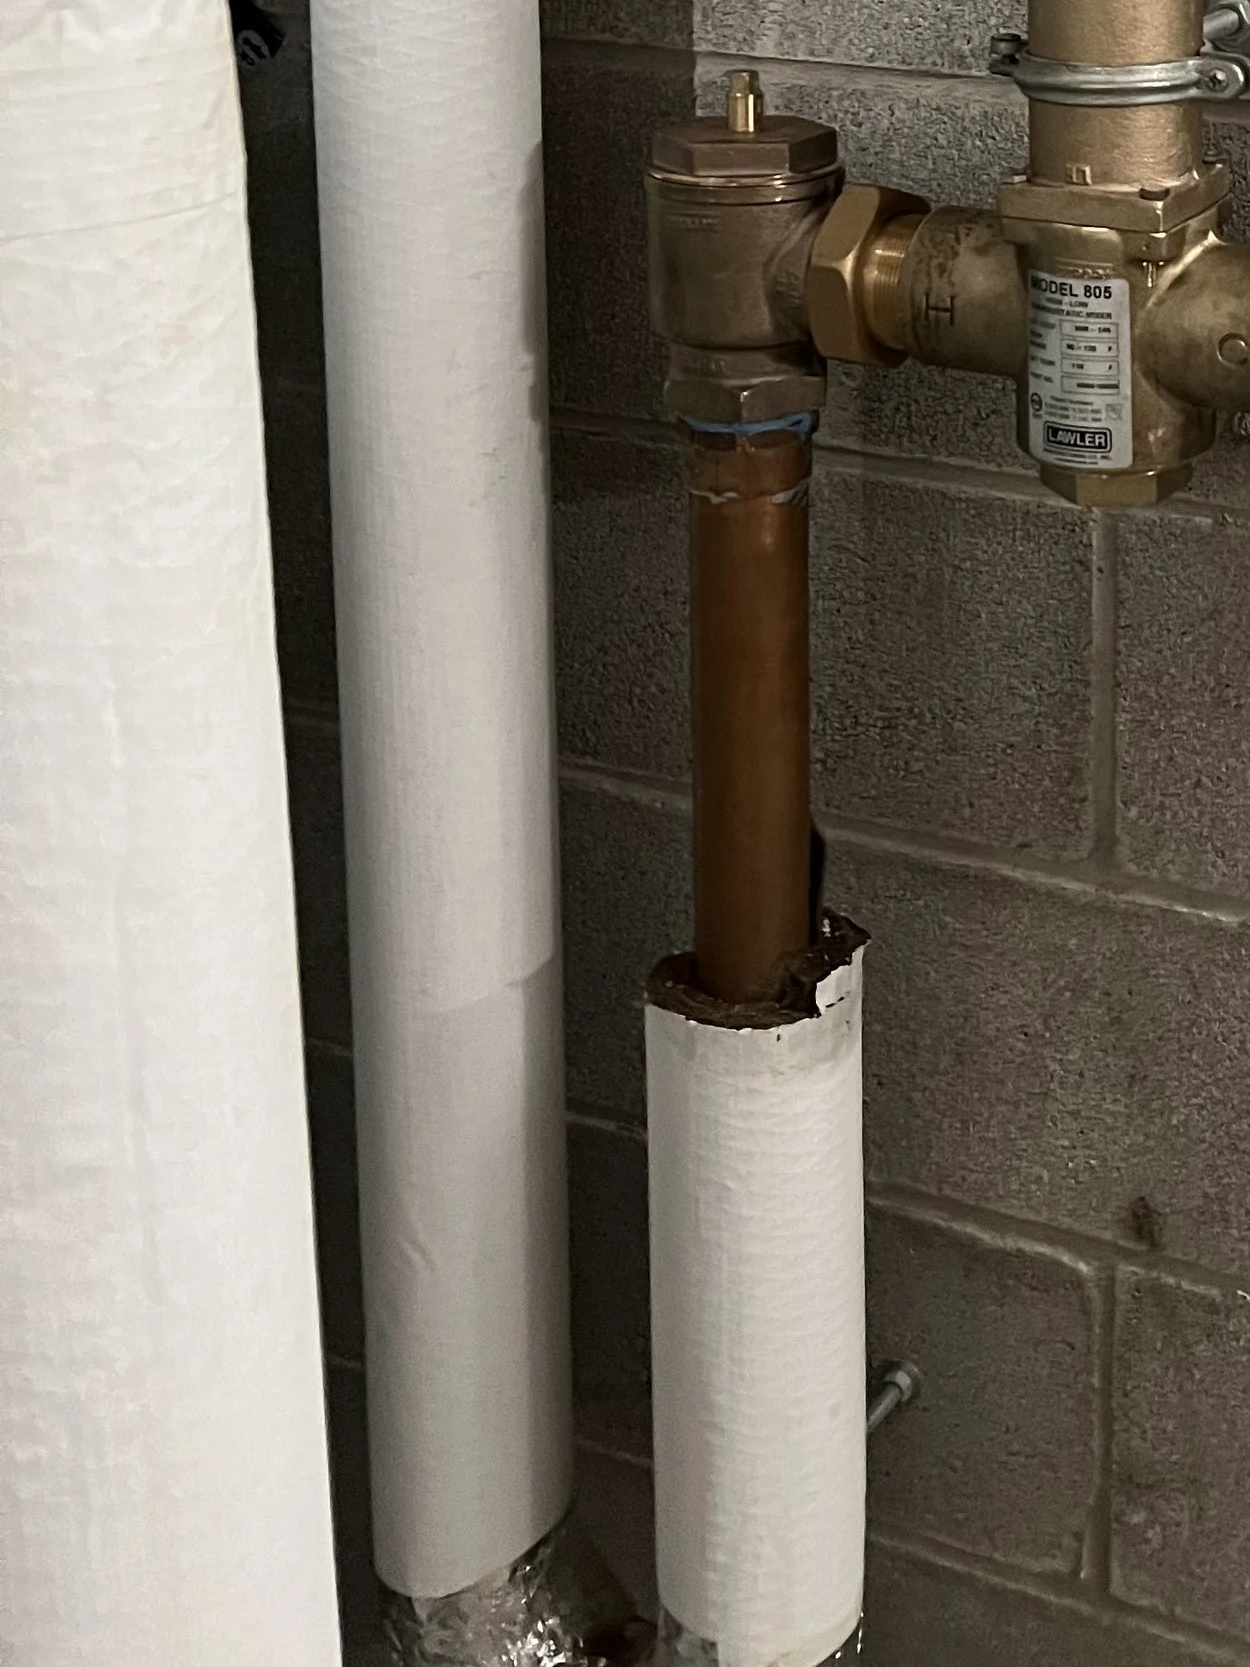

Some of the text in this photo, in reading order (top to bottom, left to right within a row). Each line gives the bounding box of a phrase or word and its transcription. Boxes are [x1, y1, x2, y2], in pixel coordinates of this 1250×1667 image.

[1031, 275, 1113, 300] MODEL 805
[1047, 428, 1107, 447] LAWLER
